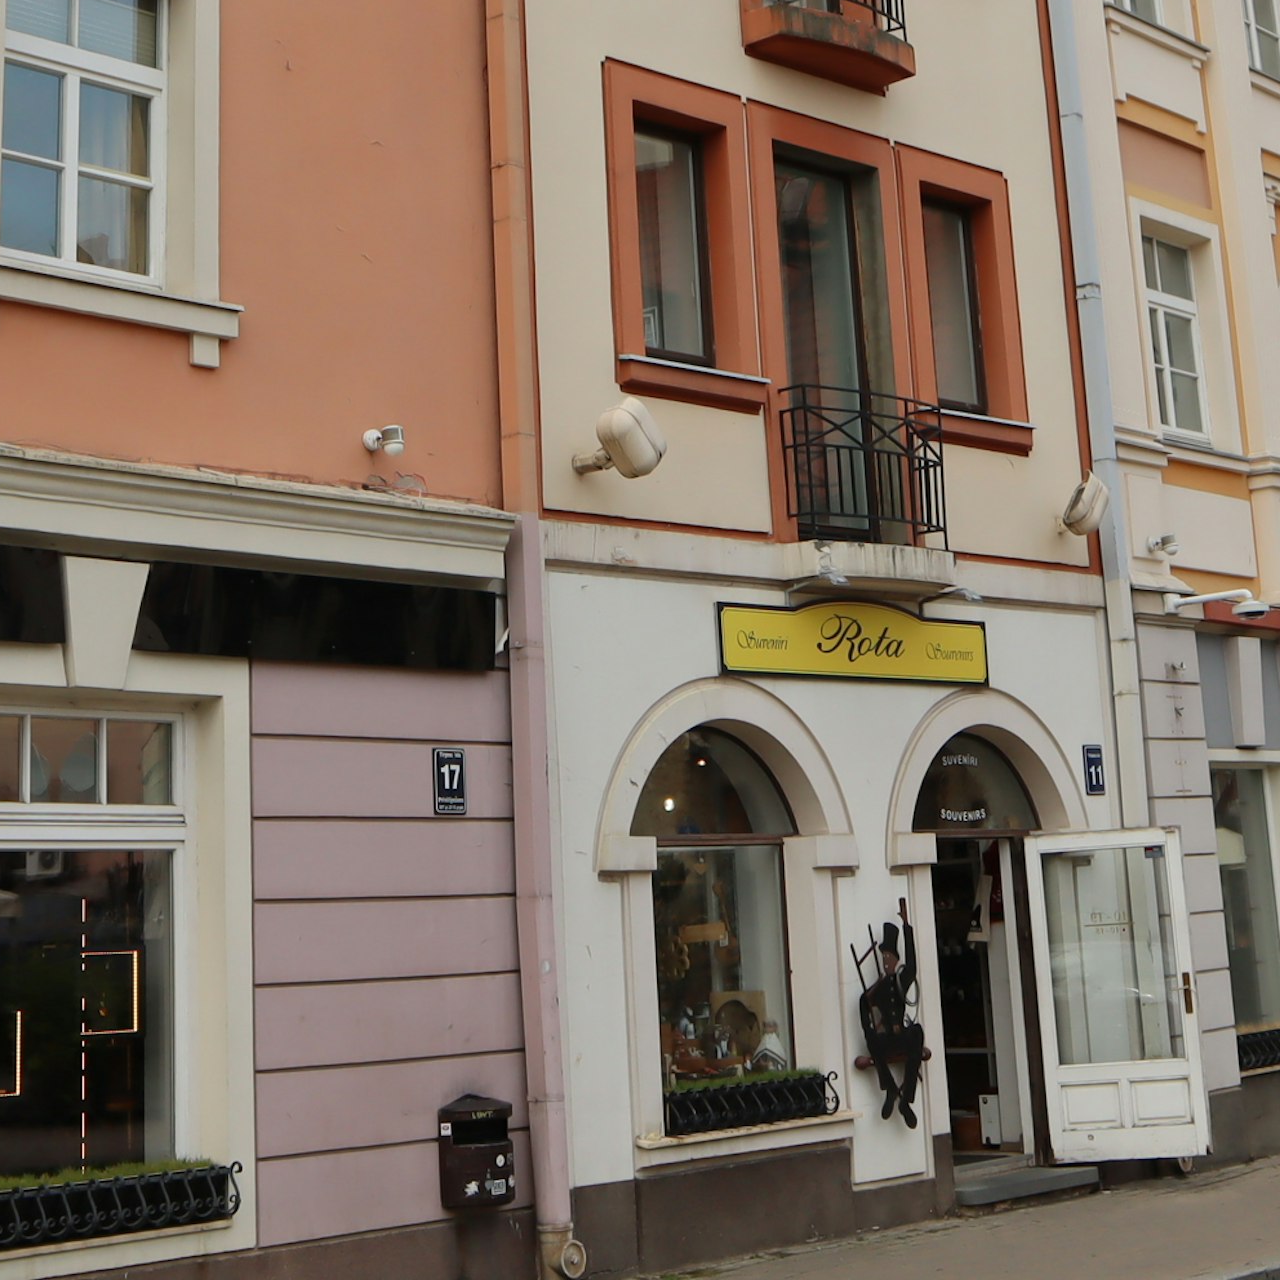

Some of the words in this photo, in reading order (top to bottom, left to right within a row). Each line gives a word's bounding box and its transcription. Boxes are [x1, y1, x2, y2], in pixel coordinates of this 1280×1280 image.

[817, 613, 905, 662] Rota
[440, 764, 460, 790] 17
[1089, 765, 1103, 785] 11
[940, 808, 986, 822] SOUVENIRS
